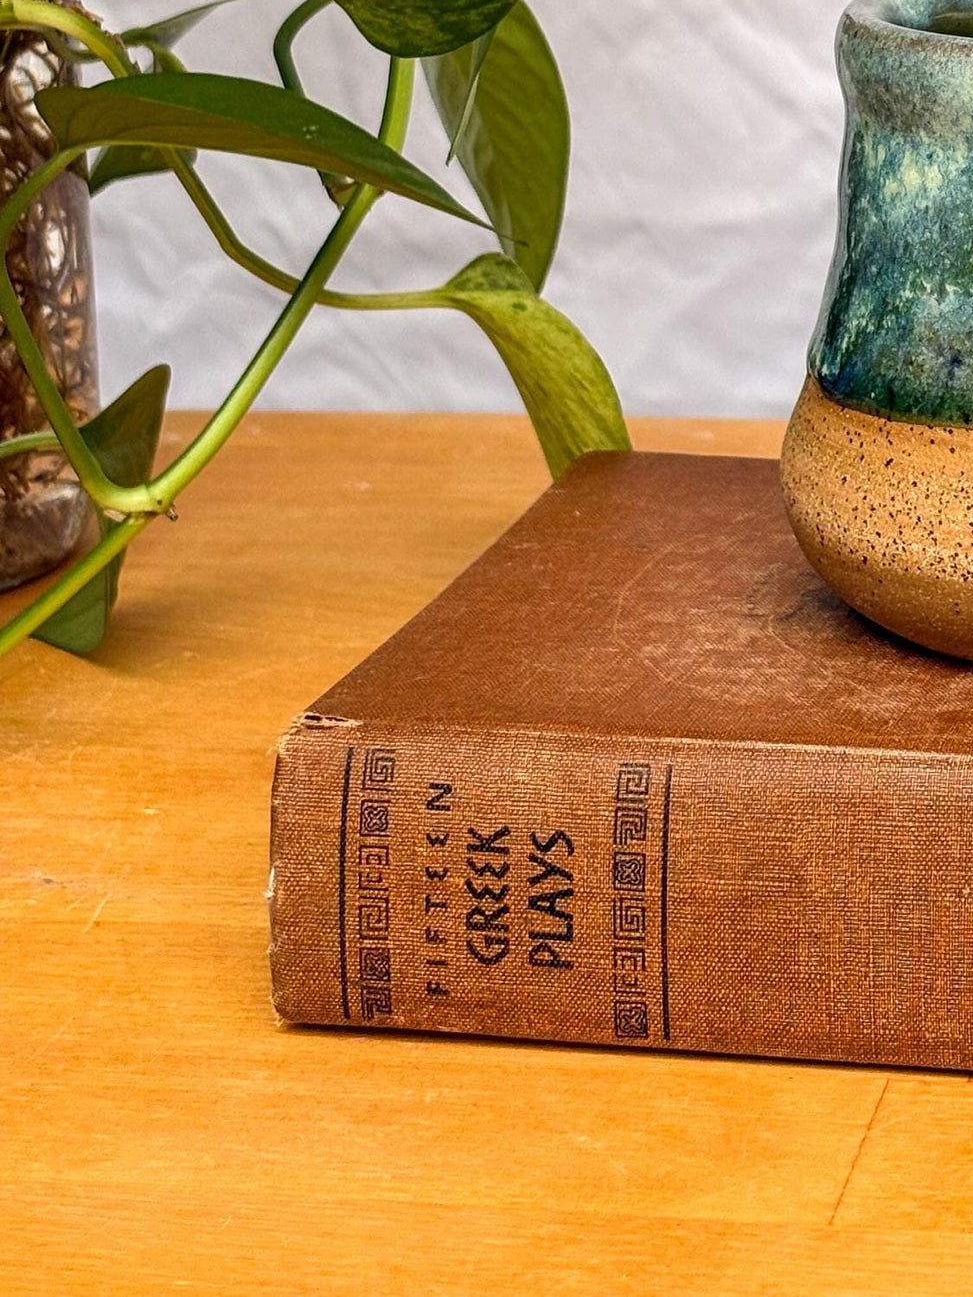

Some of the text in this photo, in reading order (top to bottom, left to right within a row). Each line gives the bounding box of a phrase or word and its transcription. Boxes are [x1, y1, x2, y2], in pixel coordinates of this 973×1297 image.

[425, 783, 452, 997] FIFTEEN
[465, 826, 510, 965] GREEK
[528, 830, 574, 969] PLAYS
